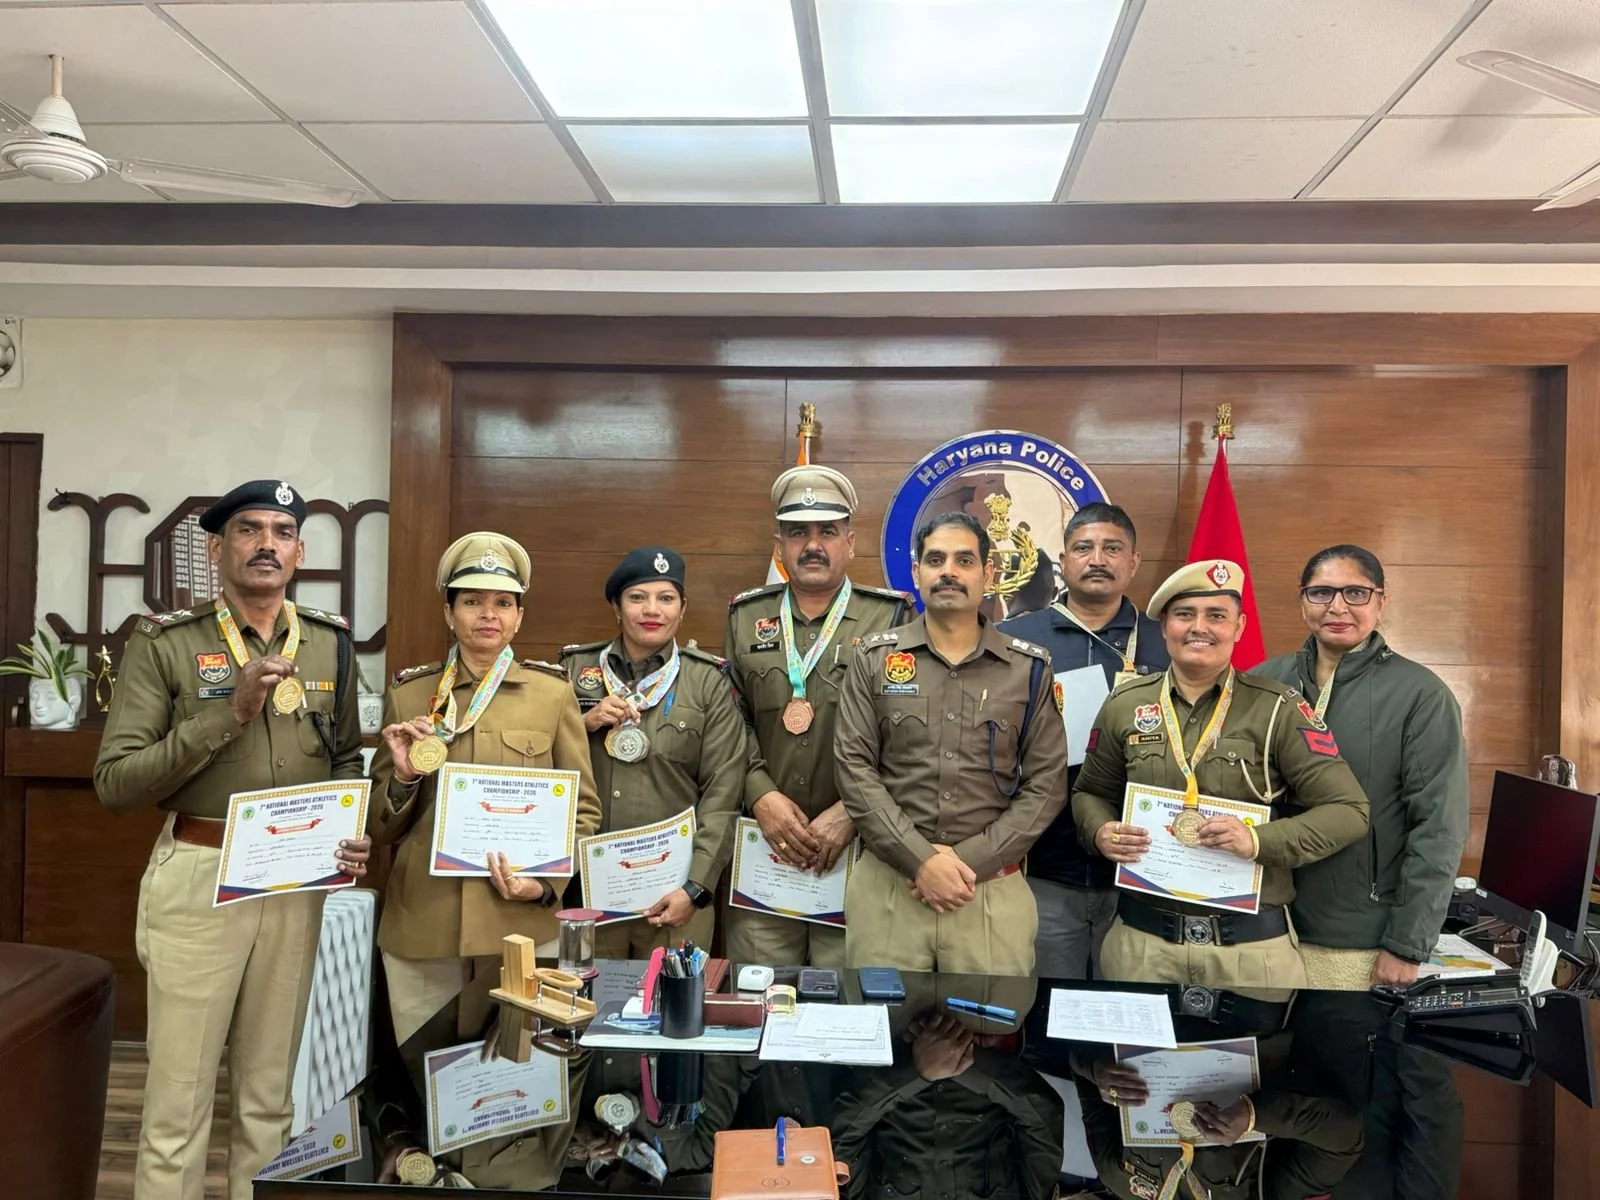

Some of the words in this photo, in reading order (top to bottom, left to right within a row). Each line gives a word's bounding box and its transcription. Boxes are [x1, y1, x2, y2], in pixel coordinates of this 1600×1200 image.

[917, 441, 1012, 487] Haryana
[1020, 441, 1086, 491] Police
[524, 781, 549, 789] ATHLETICS
[484, 787, 520, 795] CHAMPIONSHIP
[266, 800, 288, 809] NATIONAL
[290, 798, 312, 806] MASTERS
[312, 794, 337, 804] ATHLETICS
[270, 806, 308, 816] CHAMPIONSHIP
[614, 840, 636, 848] NATIONAL
[620, 844, 654, 854] CHAMPIONSHIP
